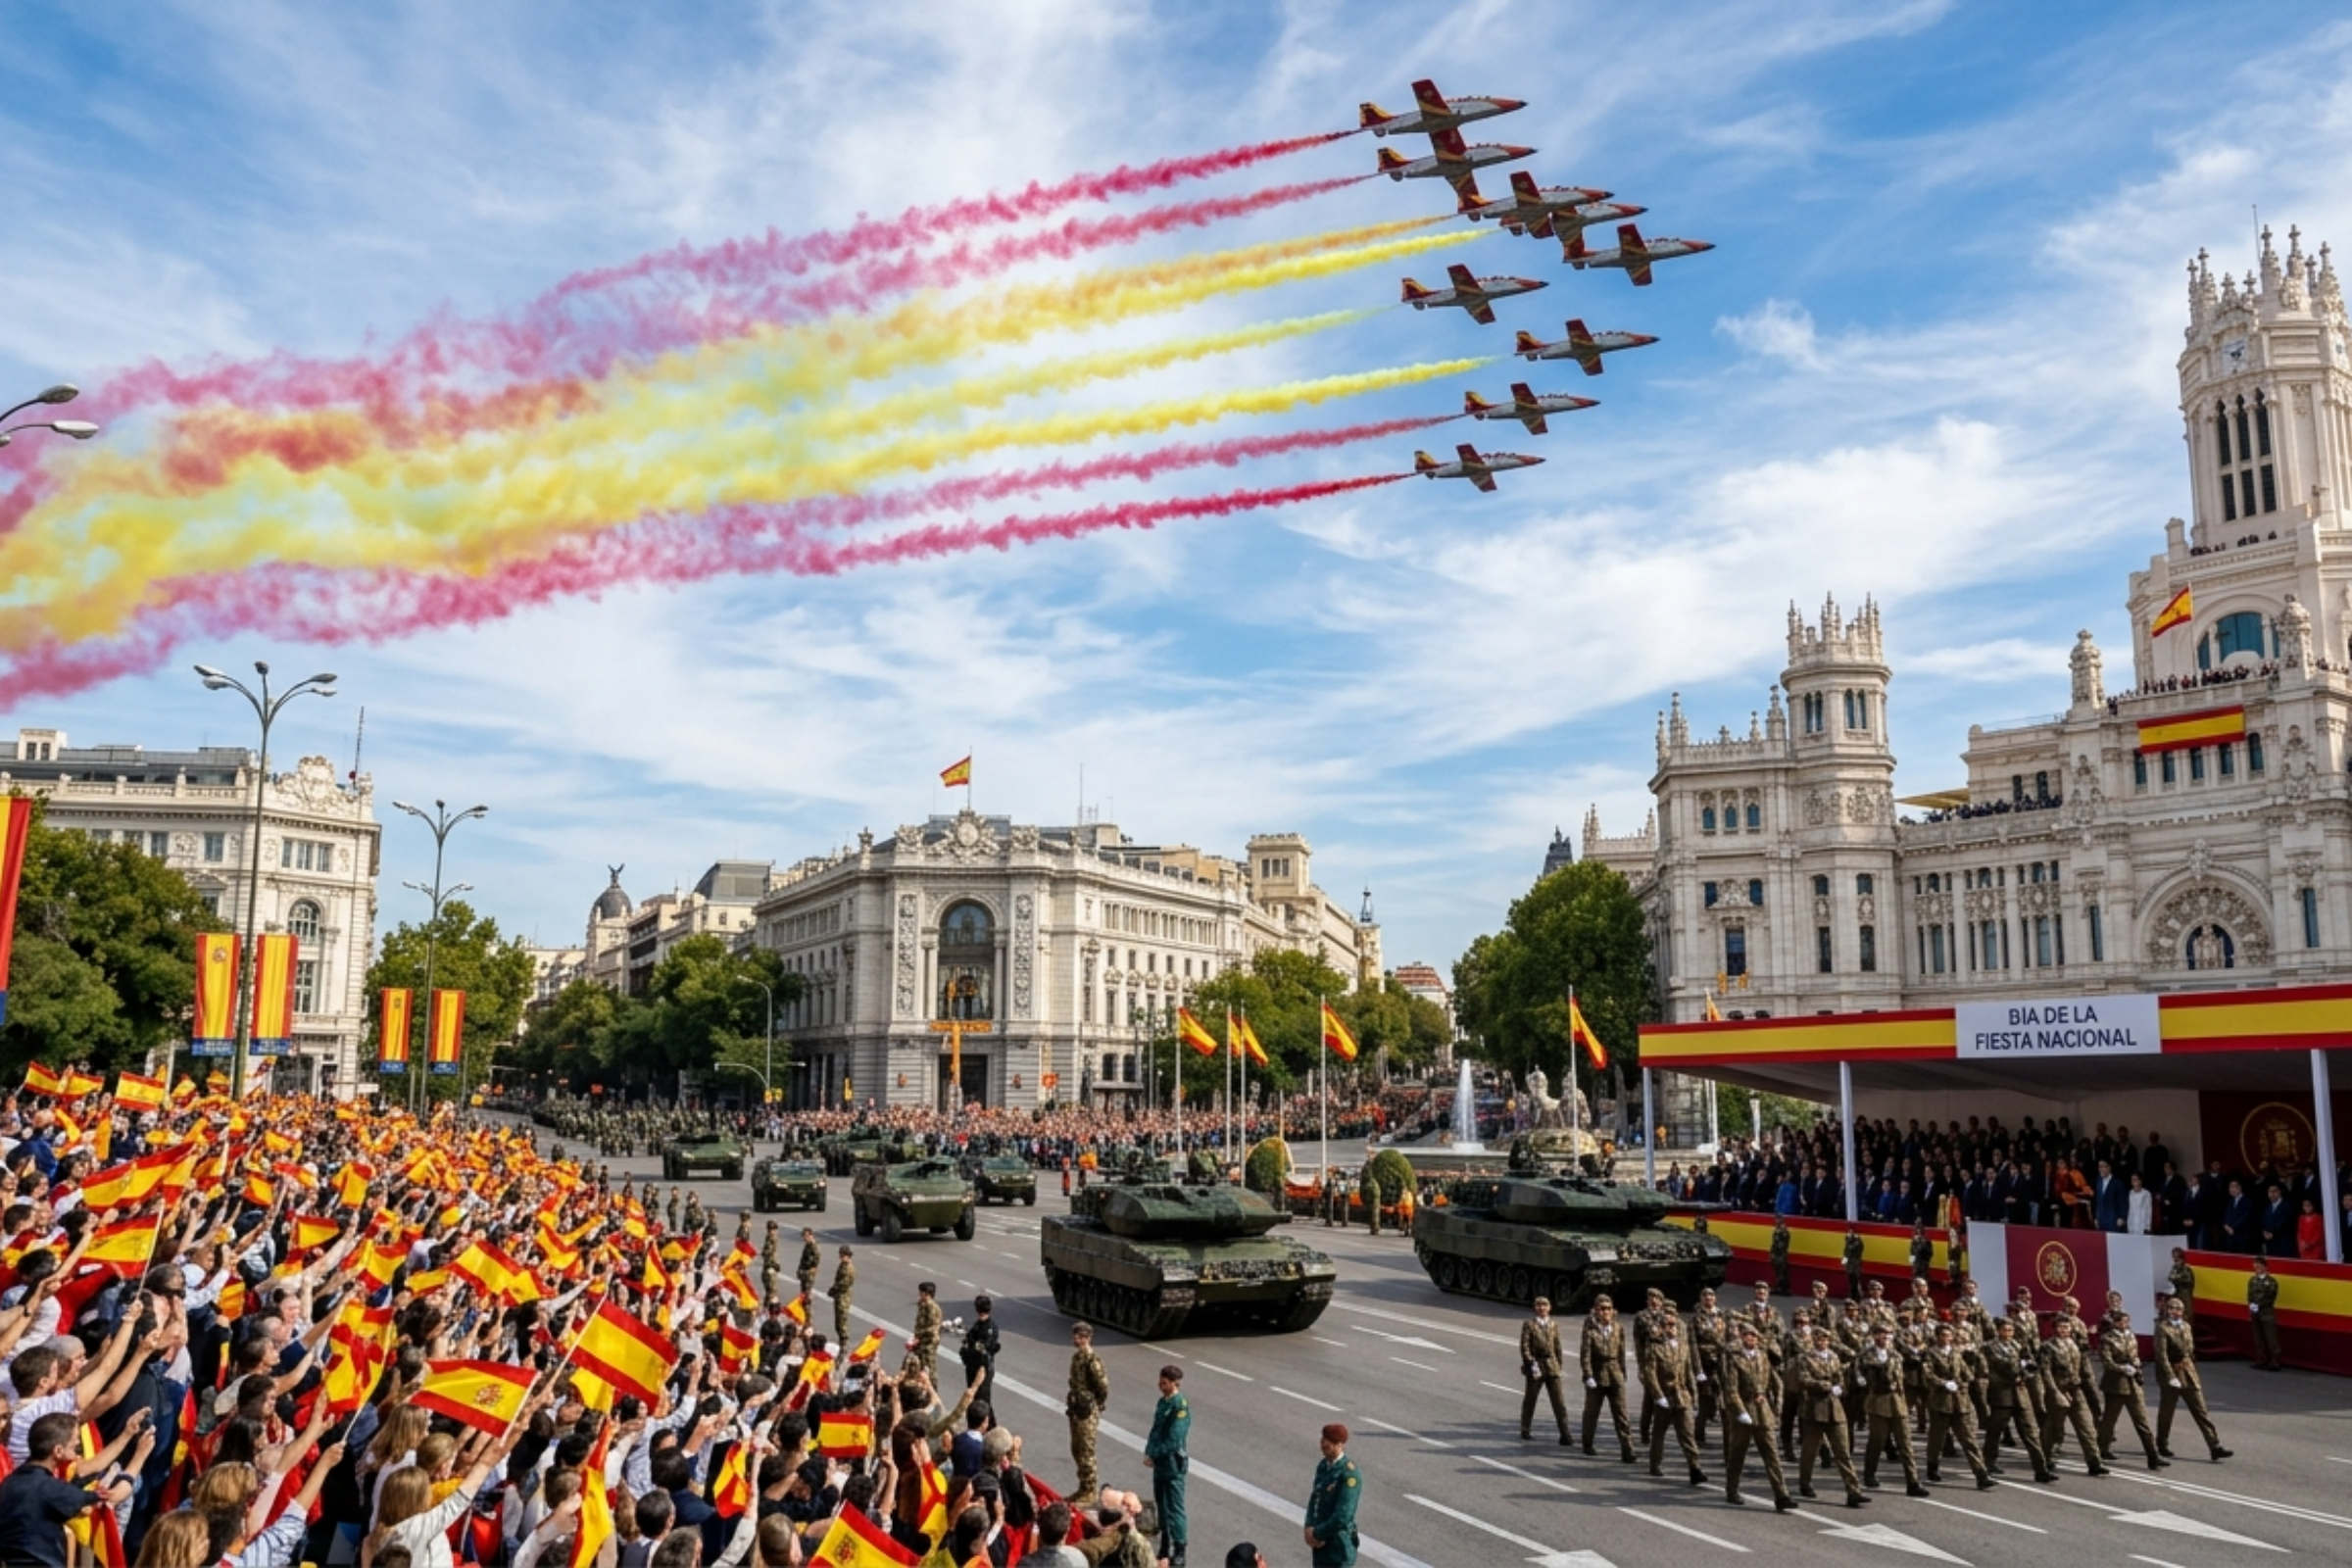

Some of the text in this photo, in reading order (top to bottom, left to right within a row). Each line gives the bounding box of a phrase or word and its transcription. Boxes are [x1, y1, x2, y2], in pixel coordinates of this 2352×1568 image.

[2044, 1005, 2069, 1024] DE
[2074, 1004, 2098, 1023] LA
[1976, 1028, 2136, 1050] FIESTA NACIONAL
